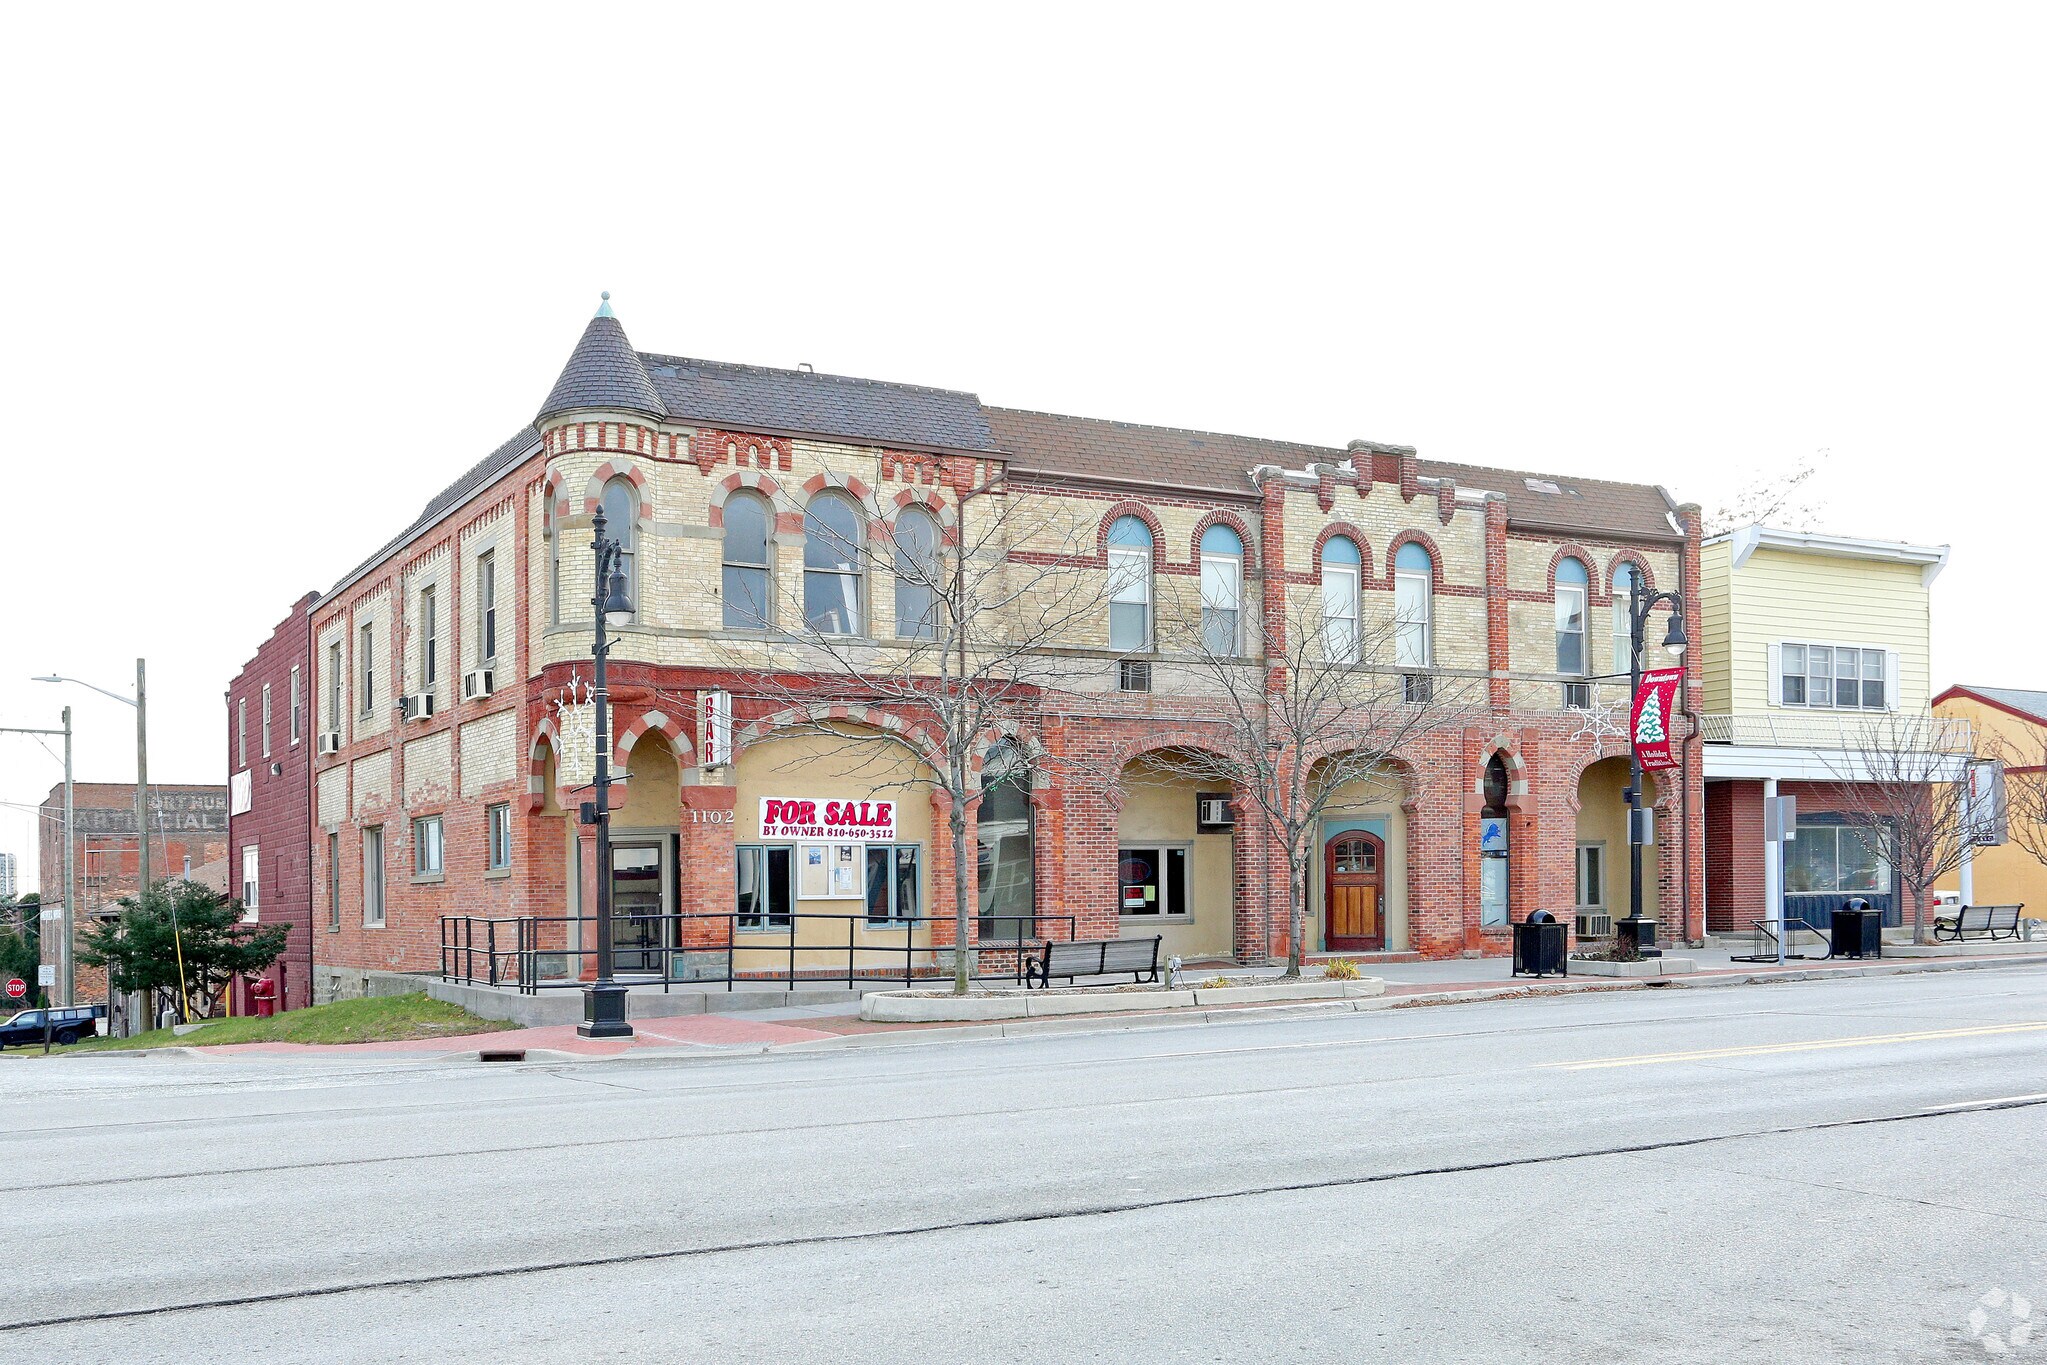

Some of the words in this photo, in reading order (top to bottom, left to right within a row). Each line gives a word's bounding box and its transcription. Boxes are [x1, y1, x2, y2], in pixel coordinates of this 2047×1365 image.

[1645, 673, 1679, 684] Downtown
[1647, 750, 1668, 760] Holiday
[692, 809, 735, 824] 1102
[764, 800, 817, 825] FOR
[824, 802, 892, 826] SALE
[74, 811, 217, 830] ARTIICIAL
[763, 825, 778, 836] BY
[781, 826, 824, 837] OWNER
